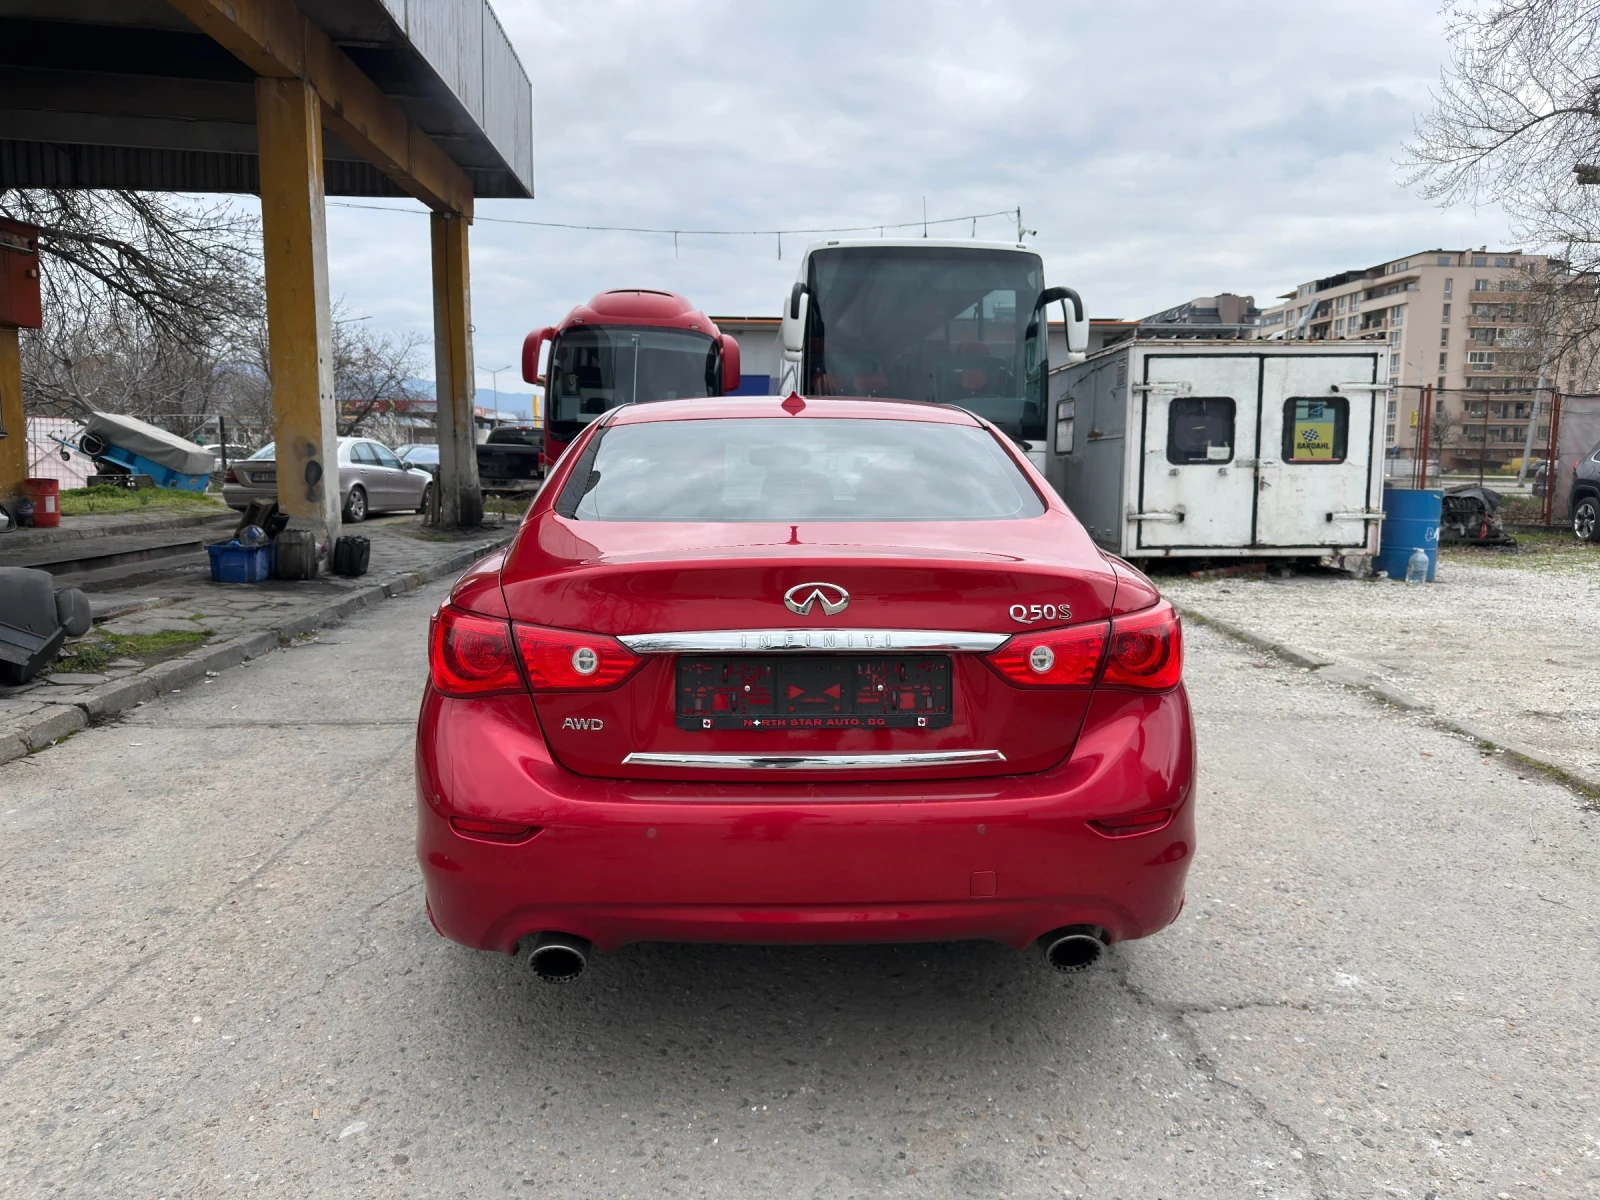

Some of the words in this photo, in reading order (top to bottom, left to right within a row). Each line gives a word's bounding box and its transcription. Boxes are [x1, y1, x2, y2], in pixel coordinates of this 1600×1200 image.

[1297, 442, 1331, 450] BARDAHL
[1009, 604, 1072, 625] Q50S
[741, 634, 892, 648] INFINITI
[561, 717, 604, 731] AWD
[789, 719, 823, 727] STAR
